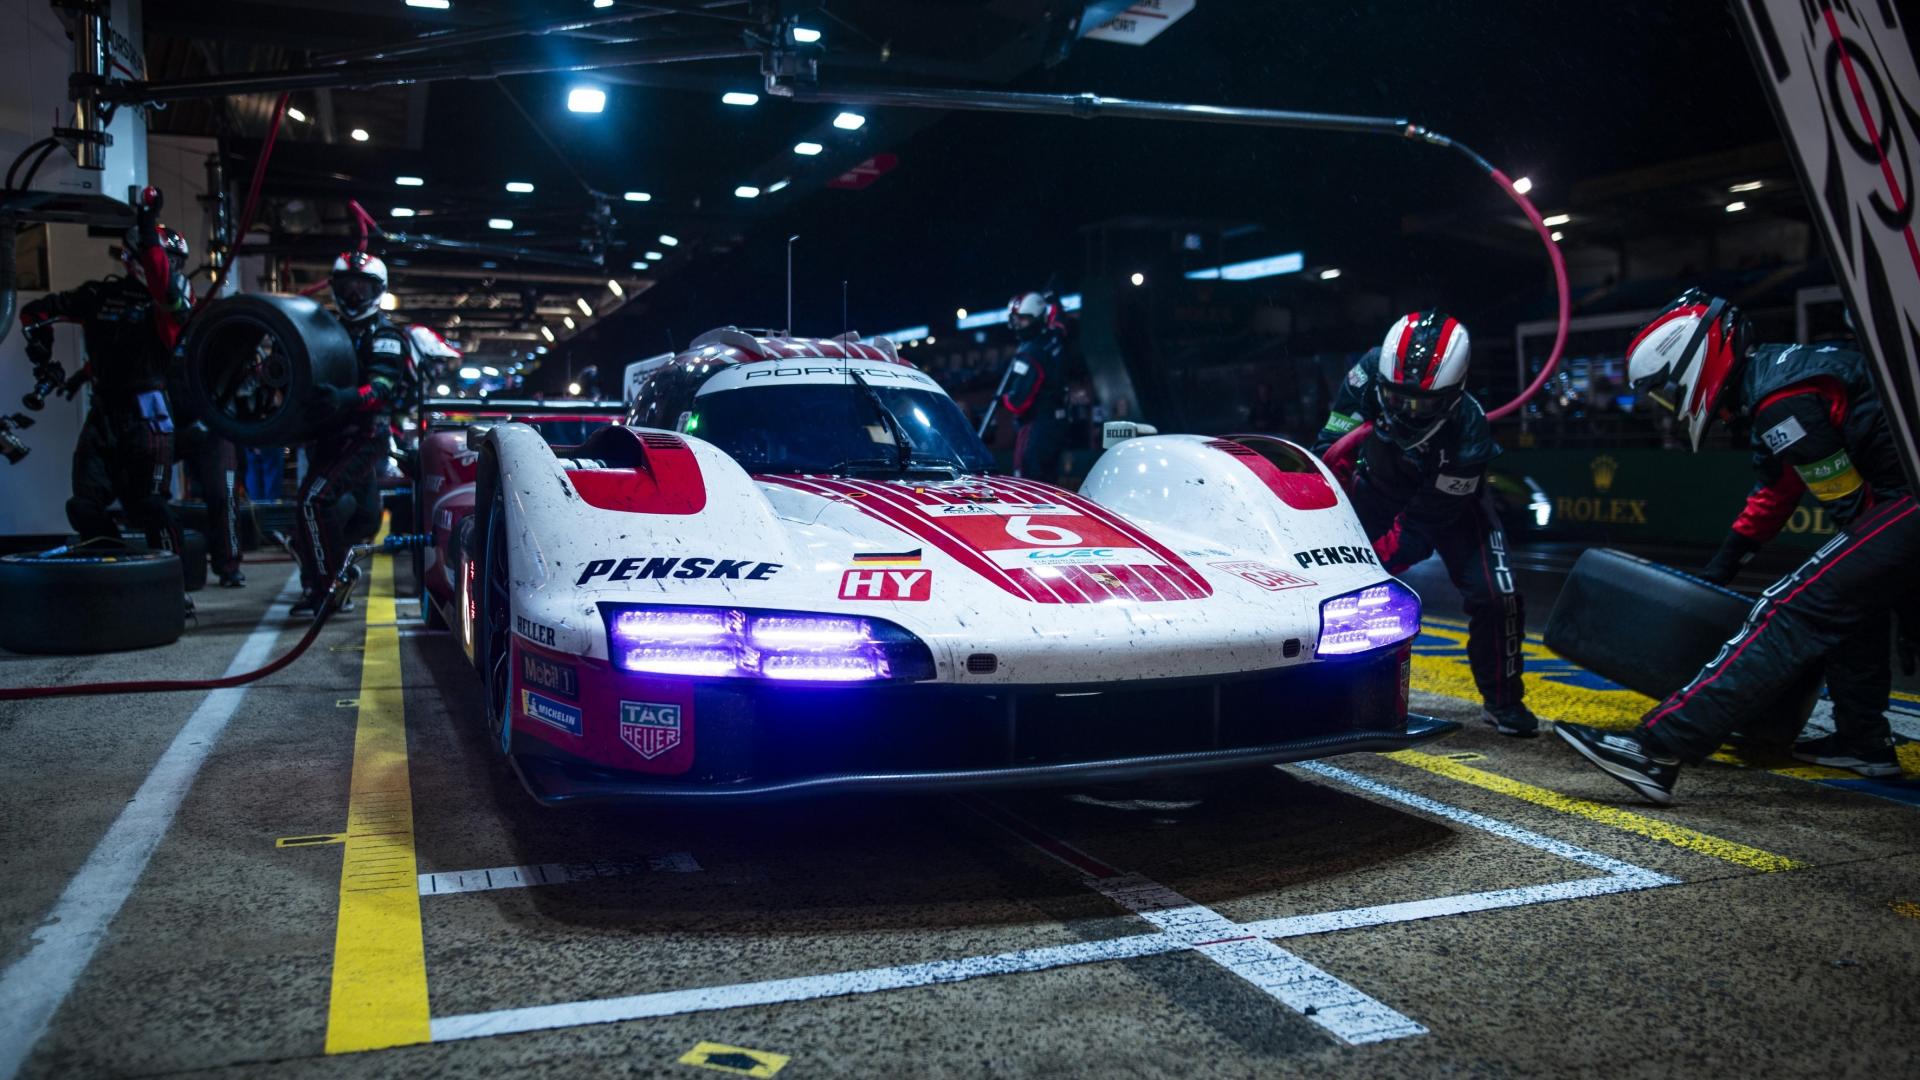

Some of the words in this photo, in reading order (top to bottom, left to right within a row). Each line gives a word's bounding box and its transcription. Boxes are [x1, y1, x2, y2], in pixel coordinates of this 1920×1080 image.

[746, 367, 931, 386] PORSCHE
[1557, 499, 1647, 524] ROLEX
[1004, 516, 1083, 546] 6
[1027, 549, 1114, 559] WEC
[1293, 545, 1378, 569] PENSKE
[576, 556, 783, 586] PENSKE
[843, 571, 926, 598] HY
[1489, 530, 1516, 678] PORSCHE
[517, 615, 556, 646] HELLER
[524, 656, 559, 688] Mobil
[538, 704, 577, 726] MICHELIN
[624, 705, 675, 725] TAG
[623, 727, 678, 755] HEUER
